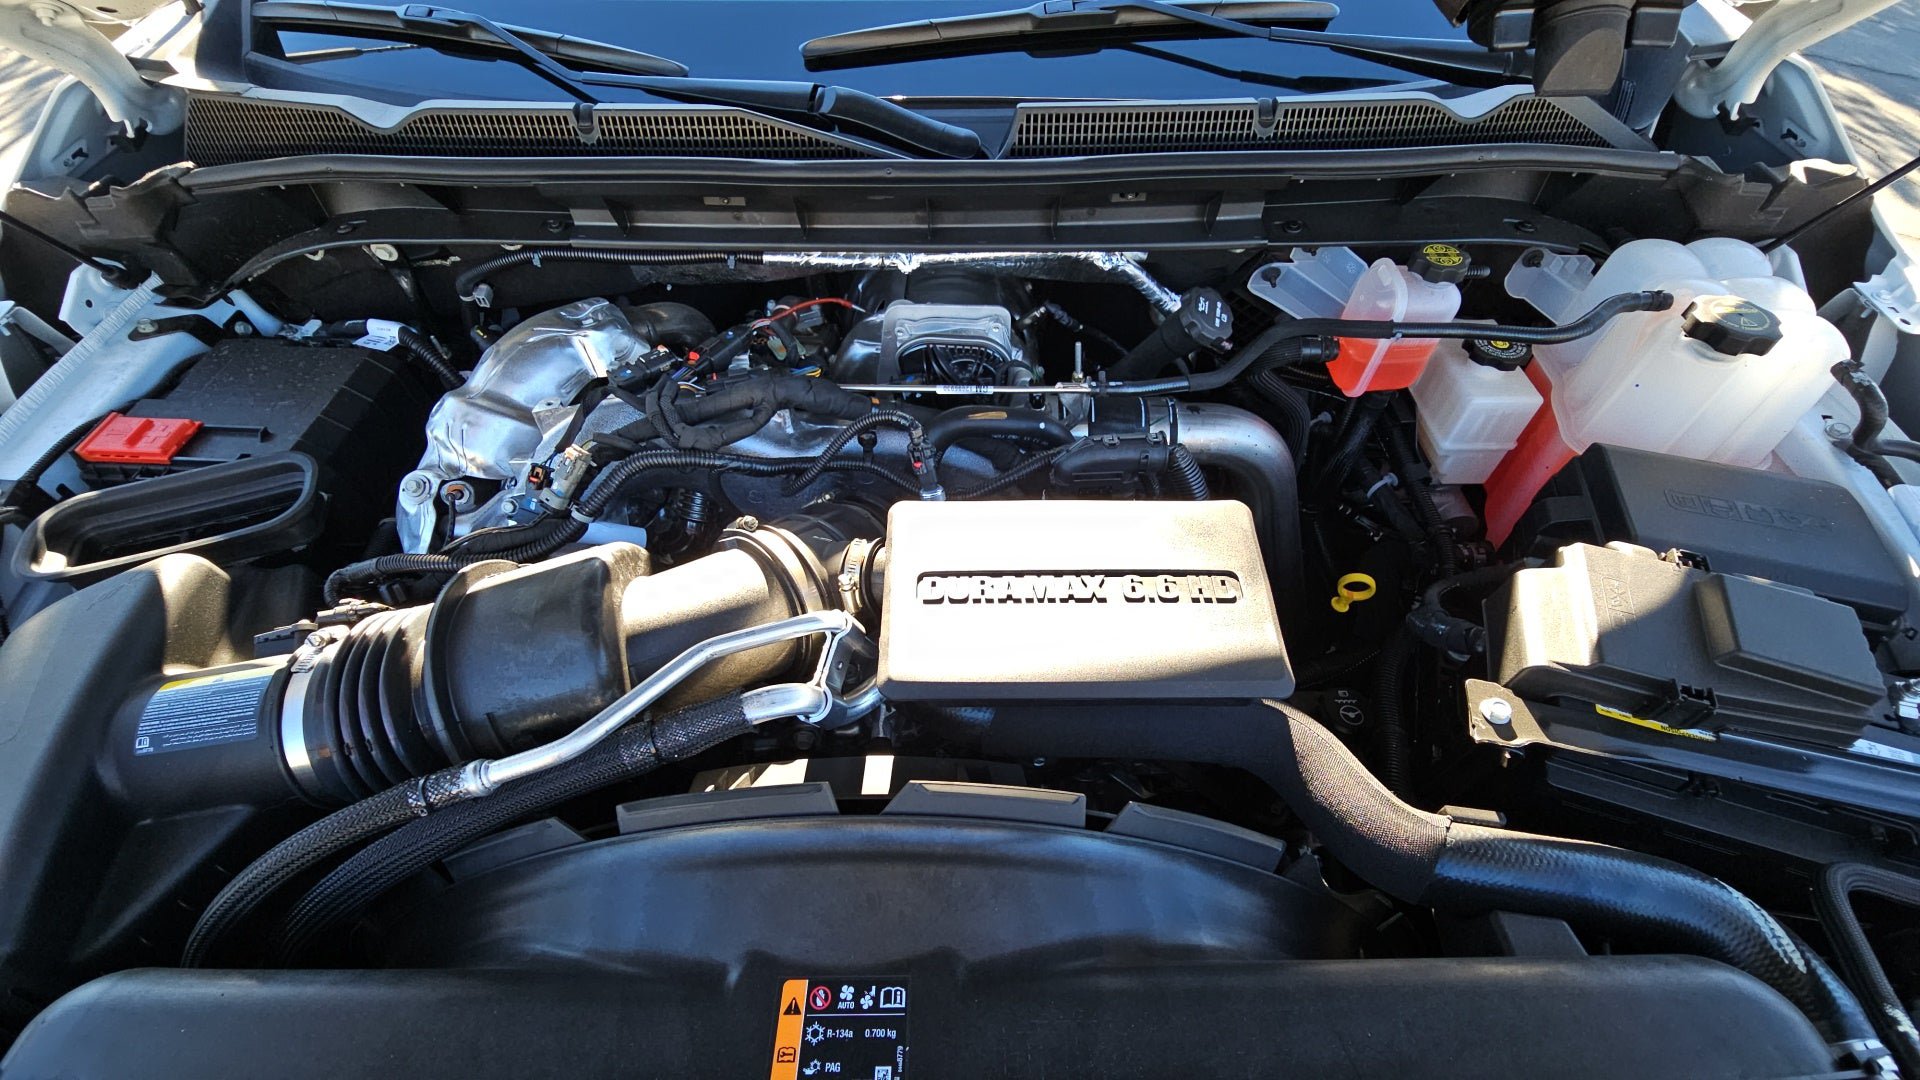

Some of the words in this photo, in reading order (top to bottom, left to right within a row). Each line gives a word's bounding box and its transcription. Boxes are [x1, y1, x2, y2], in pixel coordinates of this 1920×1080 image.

[918, 575, 1107, 604] DURAMAX
[1122, 574, 1180, 604] 6.6
[1186, 574, 1241, 604] HD
[837, 1001, 855, 1010] AUTO
[826, 1028, 854, 1038] R-134a
[864, 1028, 886, 1038] 0.700
[886, 1028, 897, 1039] kg
[825, 1062, 841, 1073] PAG
